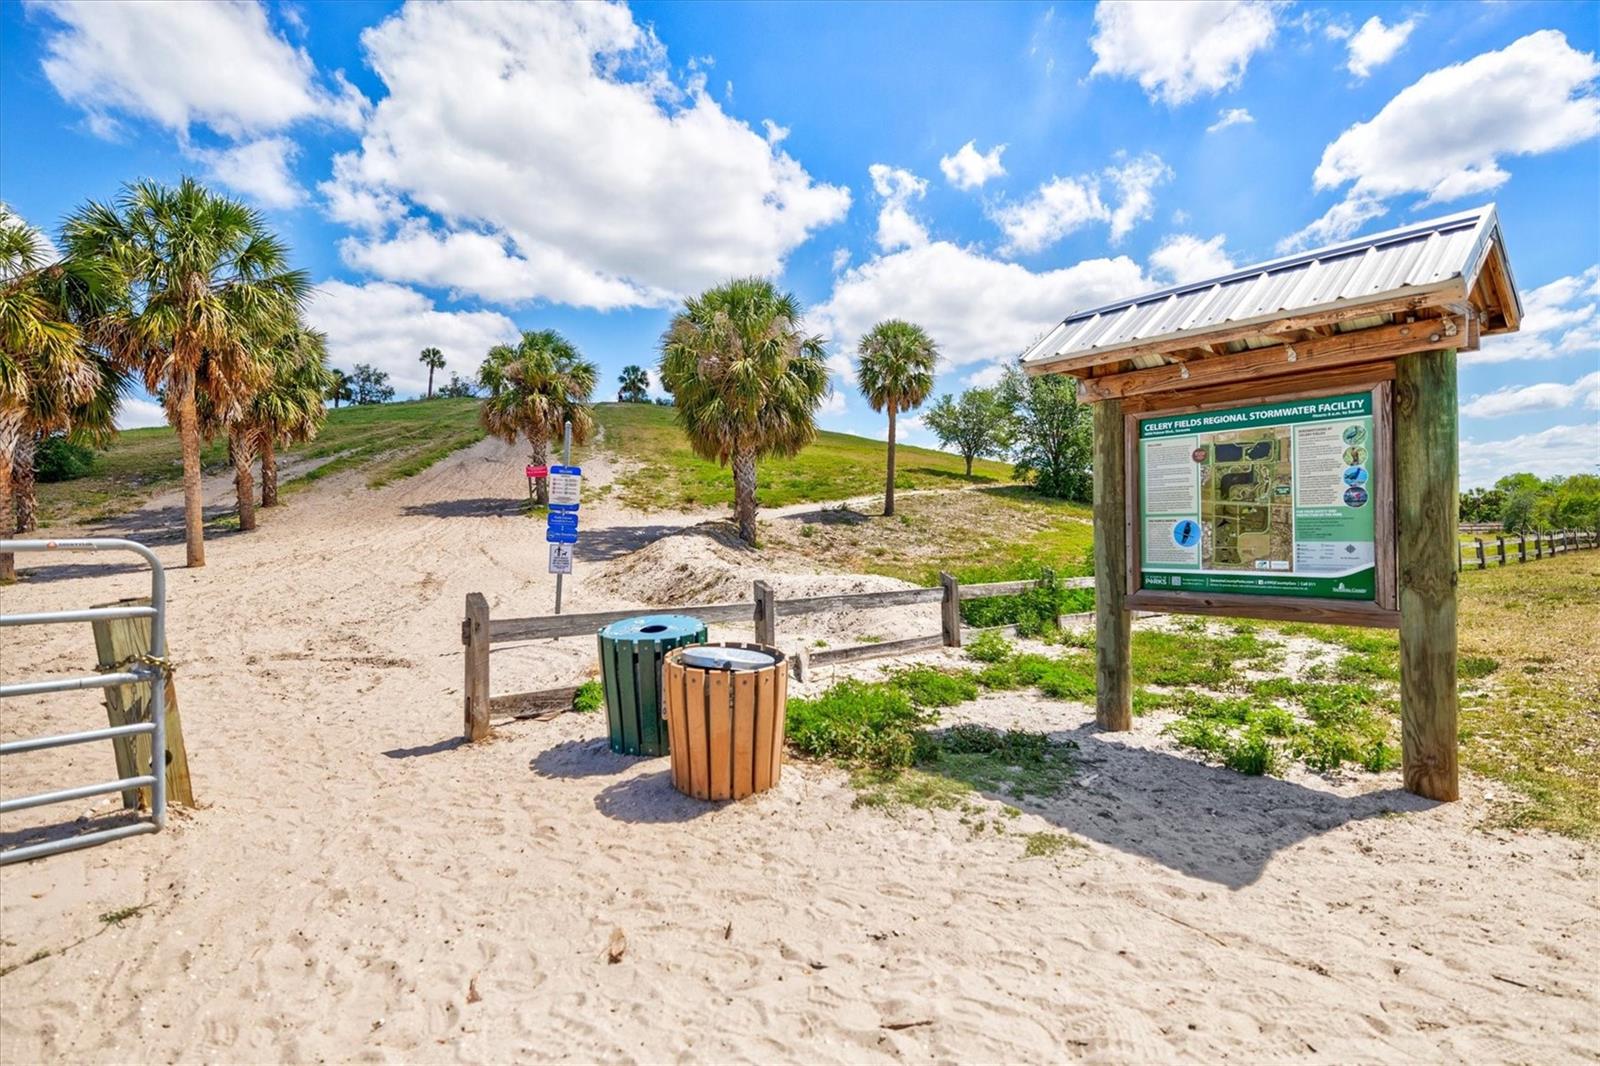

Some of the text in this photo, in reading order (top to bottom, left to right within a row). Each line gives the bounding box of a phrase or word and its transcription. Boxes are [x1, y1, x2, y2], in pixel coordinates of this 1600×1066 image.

[1144, 399, 1365, 432] CELERY FIELDS REGIONAL STORMWATER FACILITY
